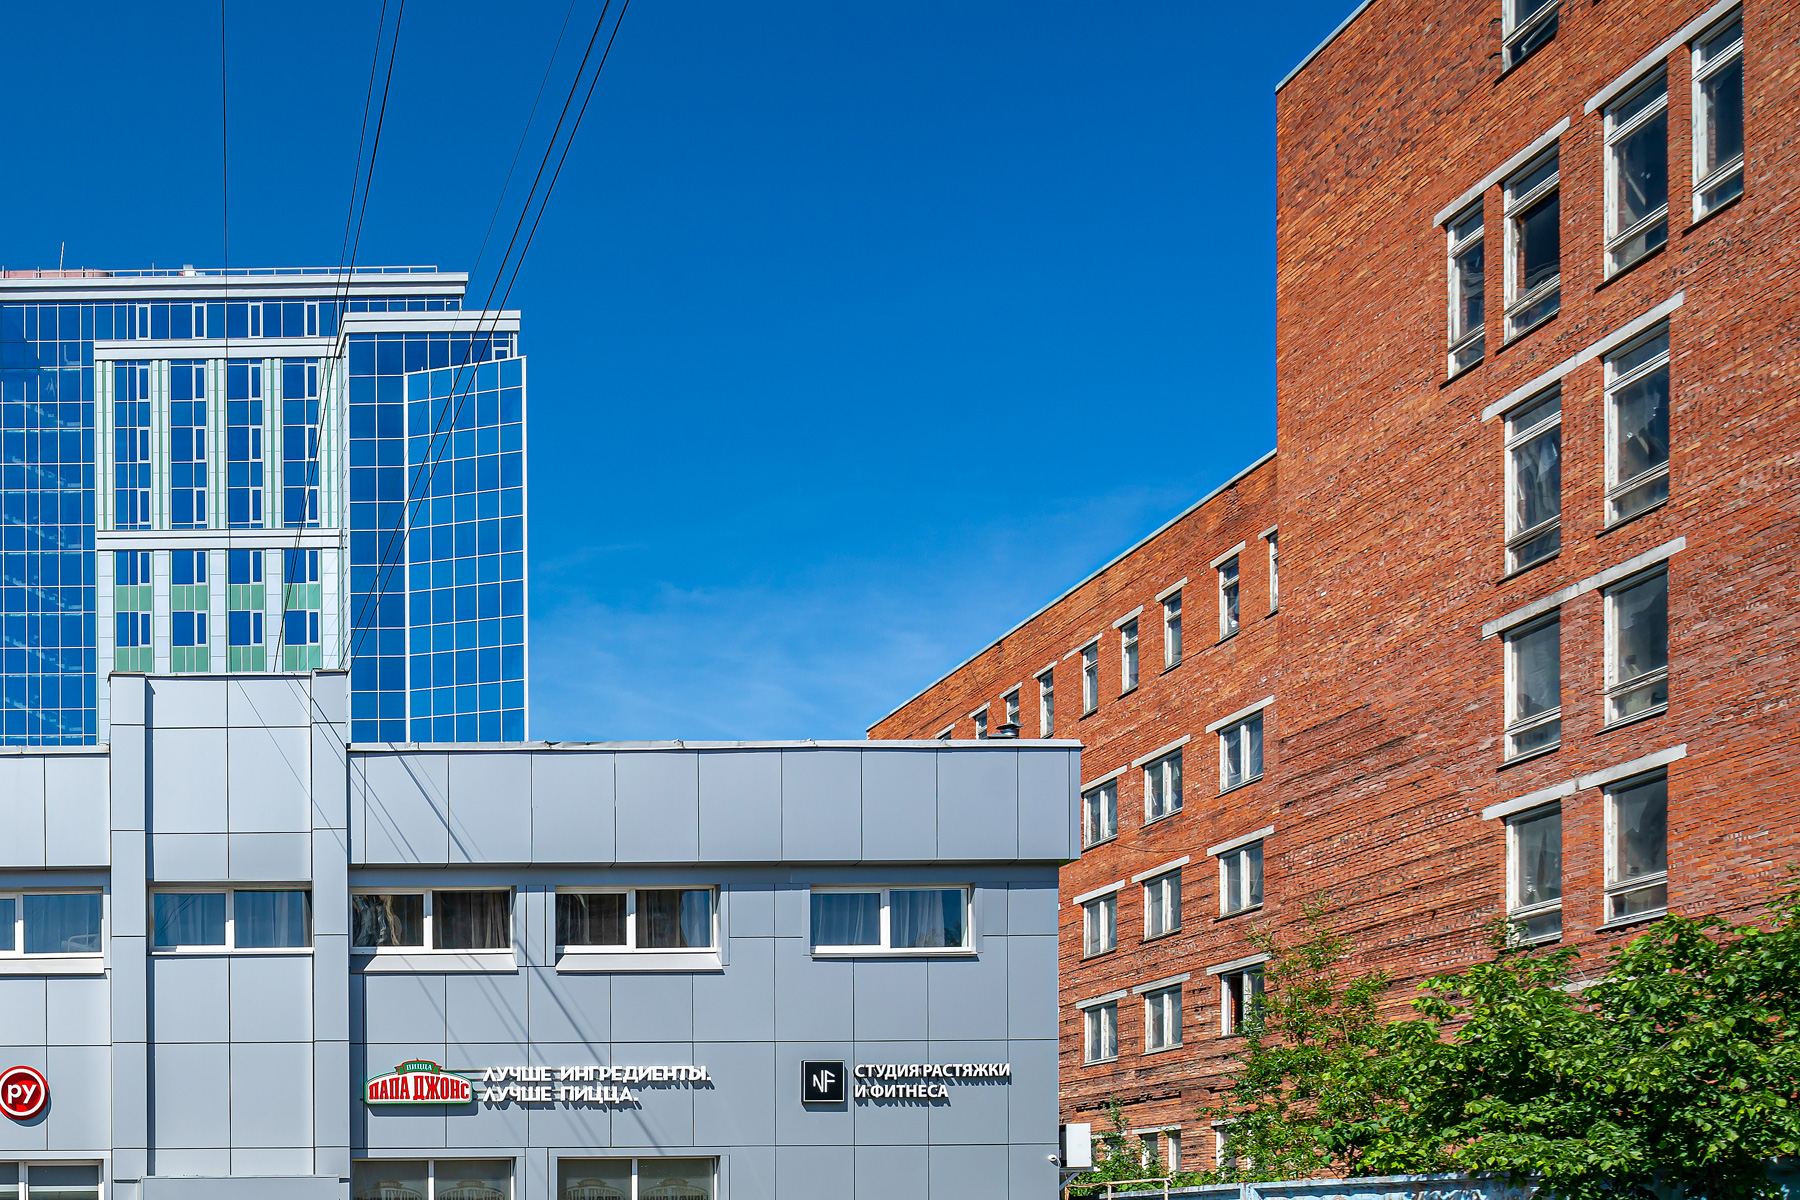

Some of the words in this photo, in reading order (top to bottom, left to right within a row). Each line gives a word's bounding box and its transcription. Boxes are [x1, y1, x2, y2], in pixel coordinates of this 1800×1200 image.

[406, 1063, 434, 1072] ПИЦЦА
[482, 1065, 552, 1082] ЛУЧШЕ
[560, 1065, 712, 1084] ИНГРЕДИЕНТЫ.
[854, 1064, 922, 1080] СТУДИЯ
[922, 1063, 1011, 1077] РАСТЯЖКИ
[368, 1077, 409, 1100] ПАПА
[413, 1075, 470, 1100] ДЖОНС
[482, 1086, 552, 1102] ЛУЧШЕ
[560, 1086, 640, 1104] ПИЦЦА.
[854, 1085, 867, 1098] И
[870, 1084, 949, 1098] ФИТНЕСА
